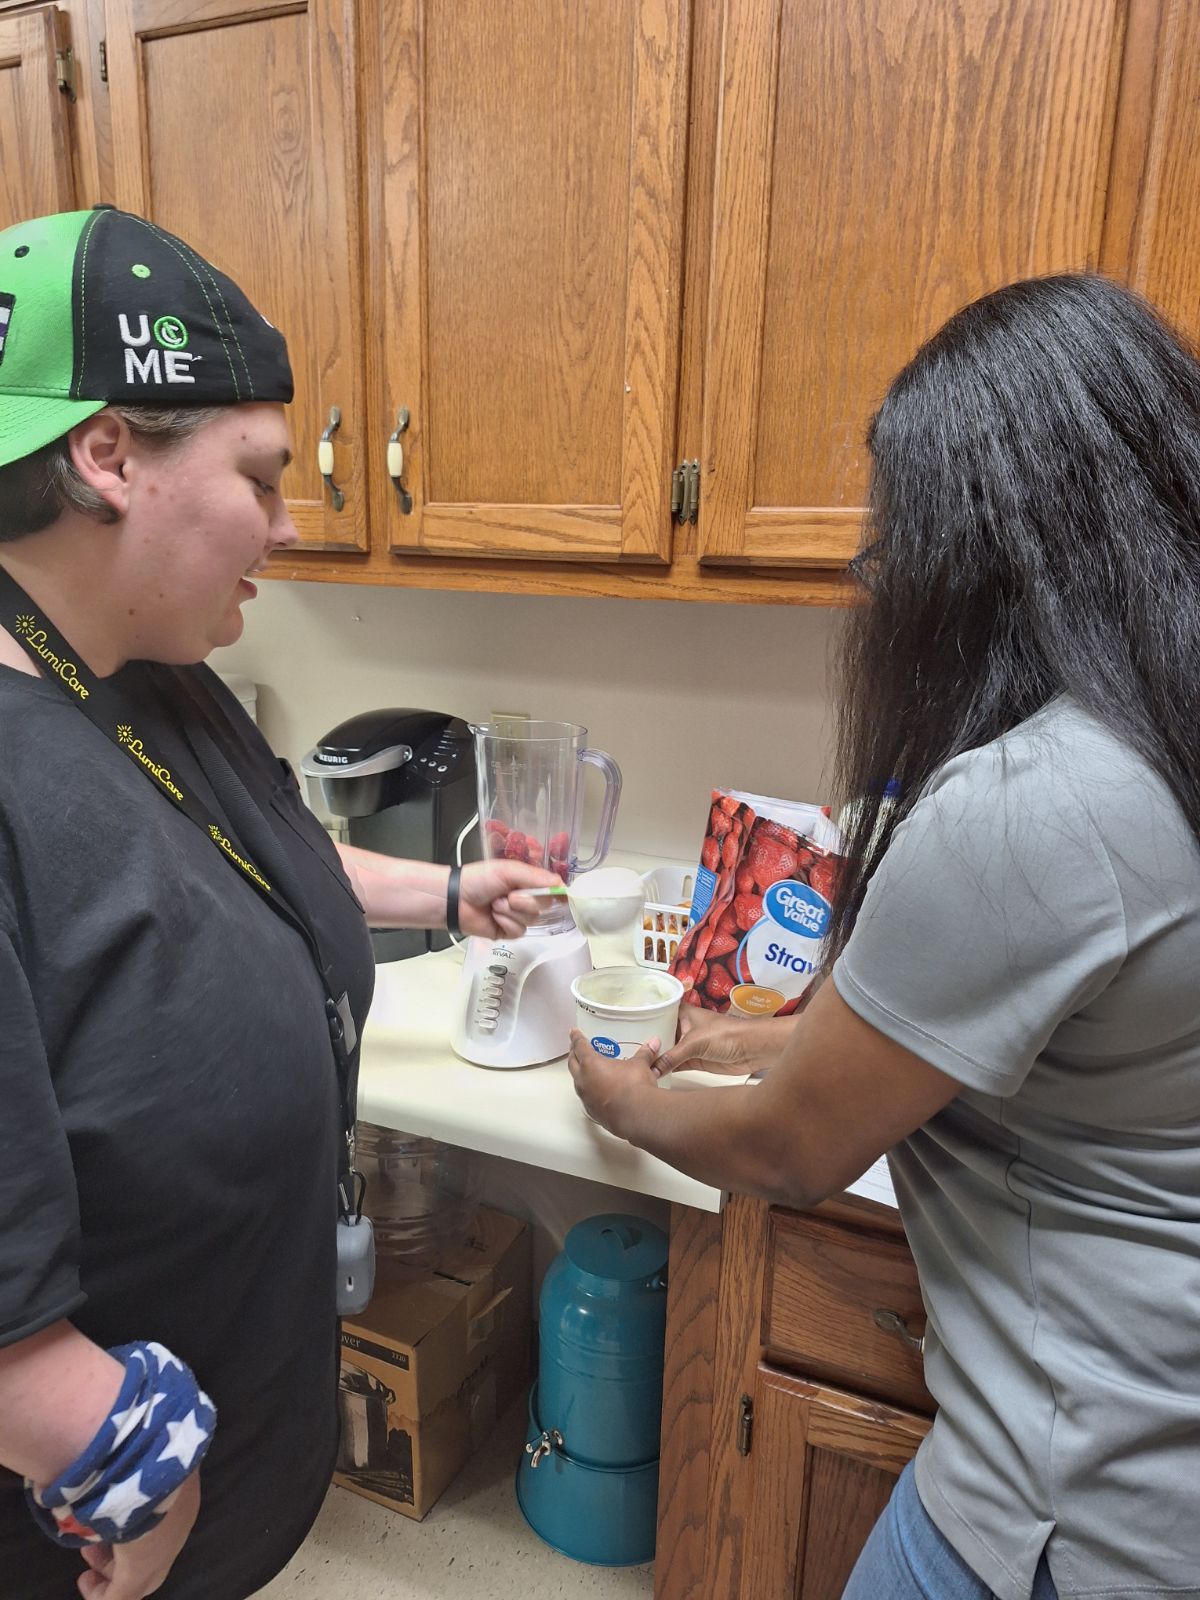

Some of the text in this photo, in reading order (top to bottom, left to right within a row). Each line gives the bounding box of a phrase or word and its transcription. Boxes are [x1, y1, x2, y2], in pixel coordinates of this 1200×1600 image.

[124, 348, 195, 384] ME
[26, 630, 89, 700] LumiCare
[128, 739, 184, 801] LumiCare
[319, 753, 349, 764] KEURIG
[220, 837, 271, 891] LumiCare
[776, 886, 826, 924] Great
[784, 905, 820, 933] Value
[593, 1039, 615, 1052] Great
[598, 1046, 615, 1056] Value
